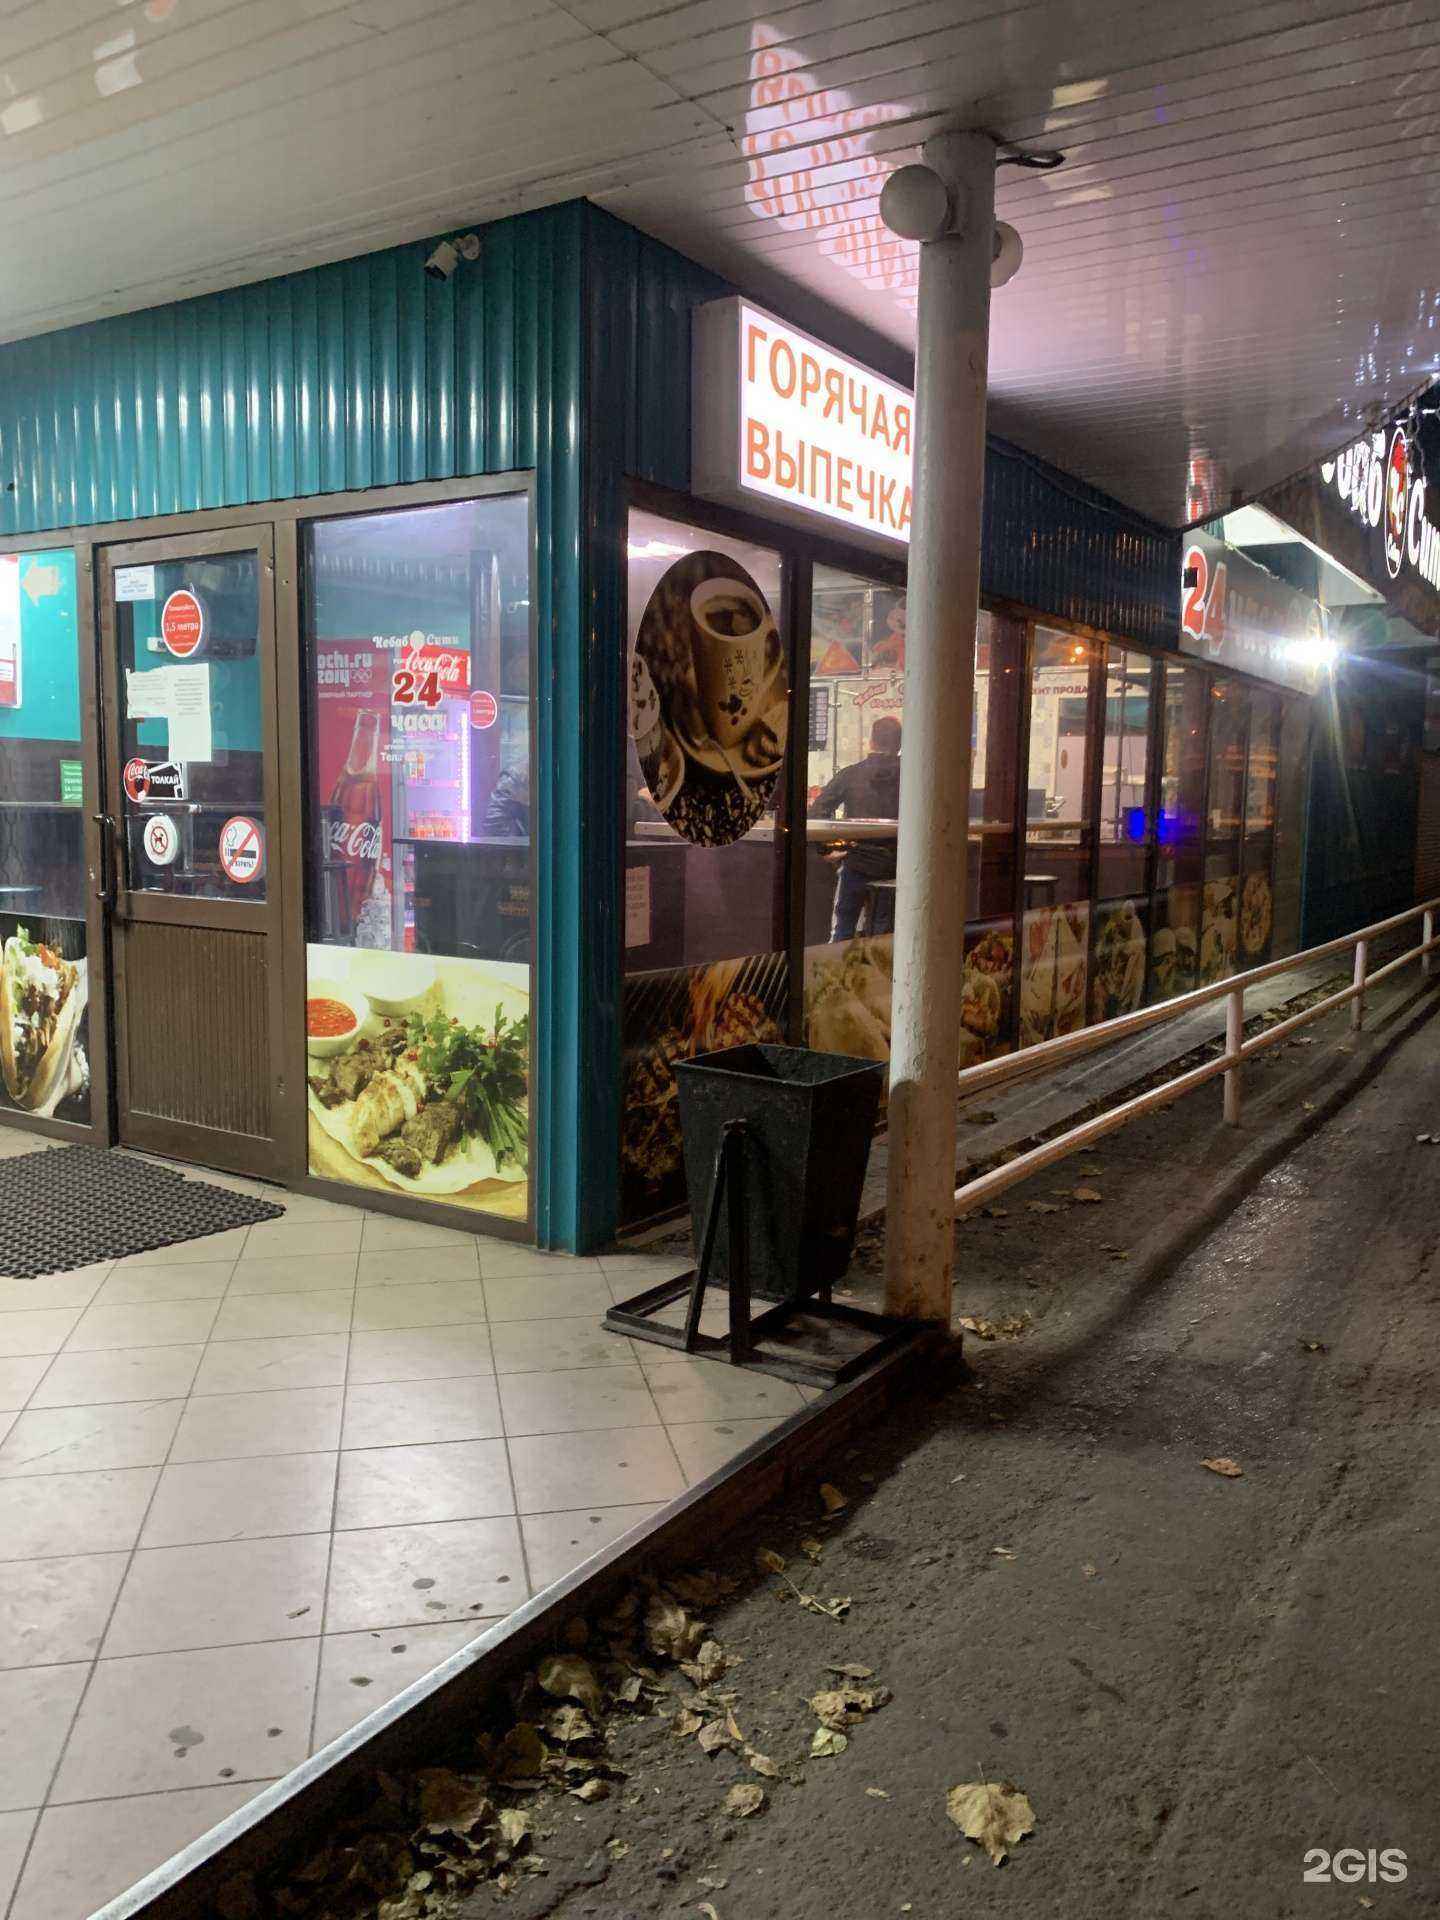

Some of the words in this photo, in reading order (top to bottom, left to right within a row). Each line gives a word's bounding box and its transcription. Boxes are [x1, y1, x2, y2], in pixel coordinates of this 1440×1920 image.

[747, 324, 912, 456] ГОРЯЧАЯ
[746, 417, 912, 530] ВЫПЕЧКА
[372, 635, 408, 648] Кебаб
[317, 650, 374, 670] ochi.ru
[317, 669, 350, 688] 2014
[391, 670, 443, 711] 24
[391, 713, 445, 731] часа
[151, 774, 179, 785] ТОЛКАЙ
